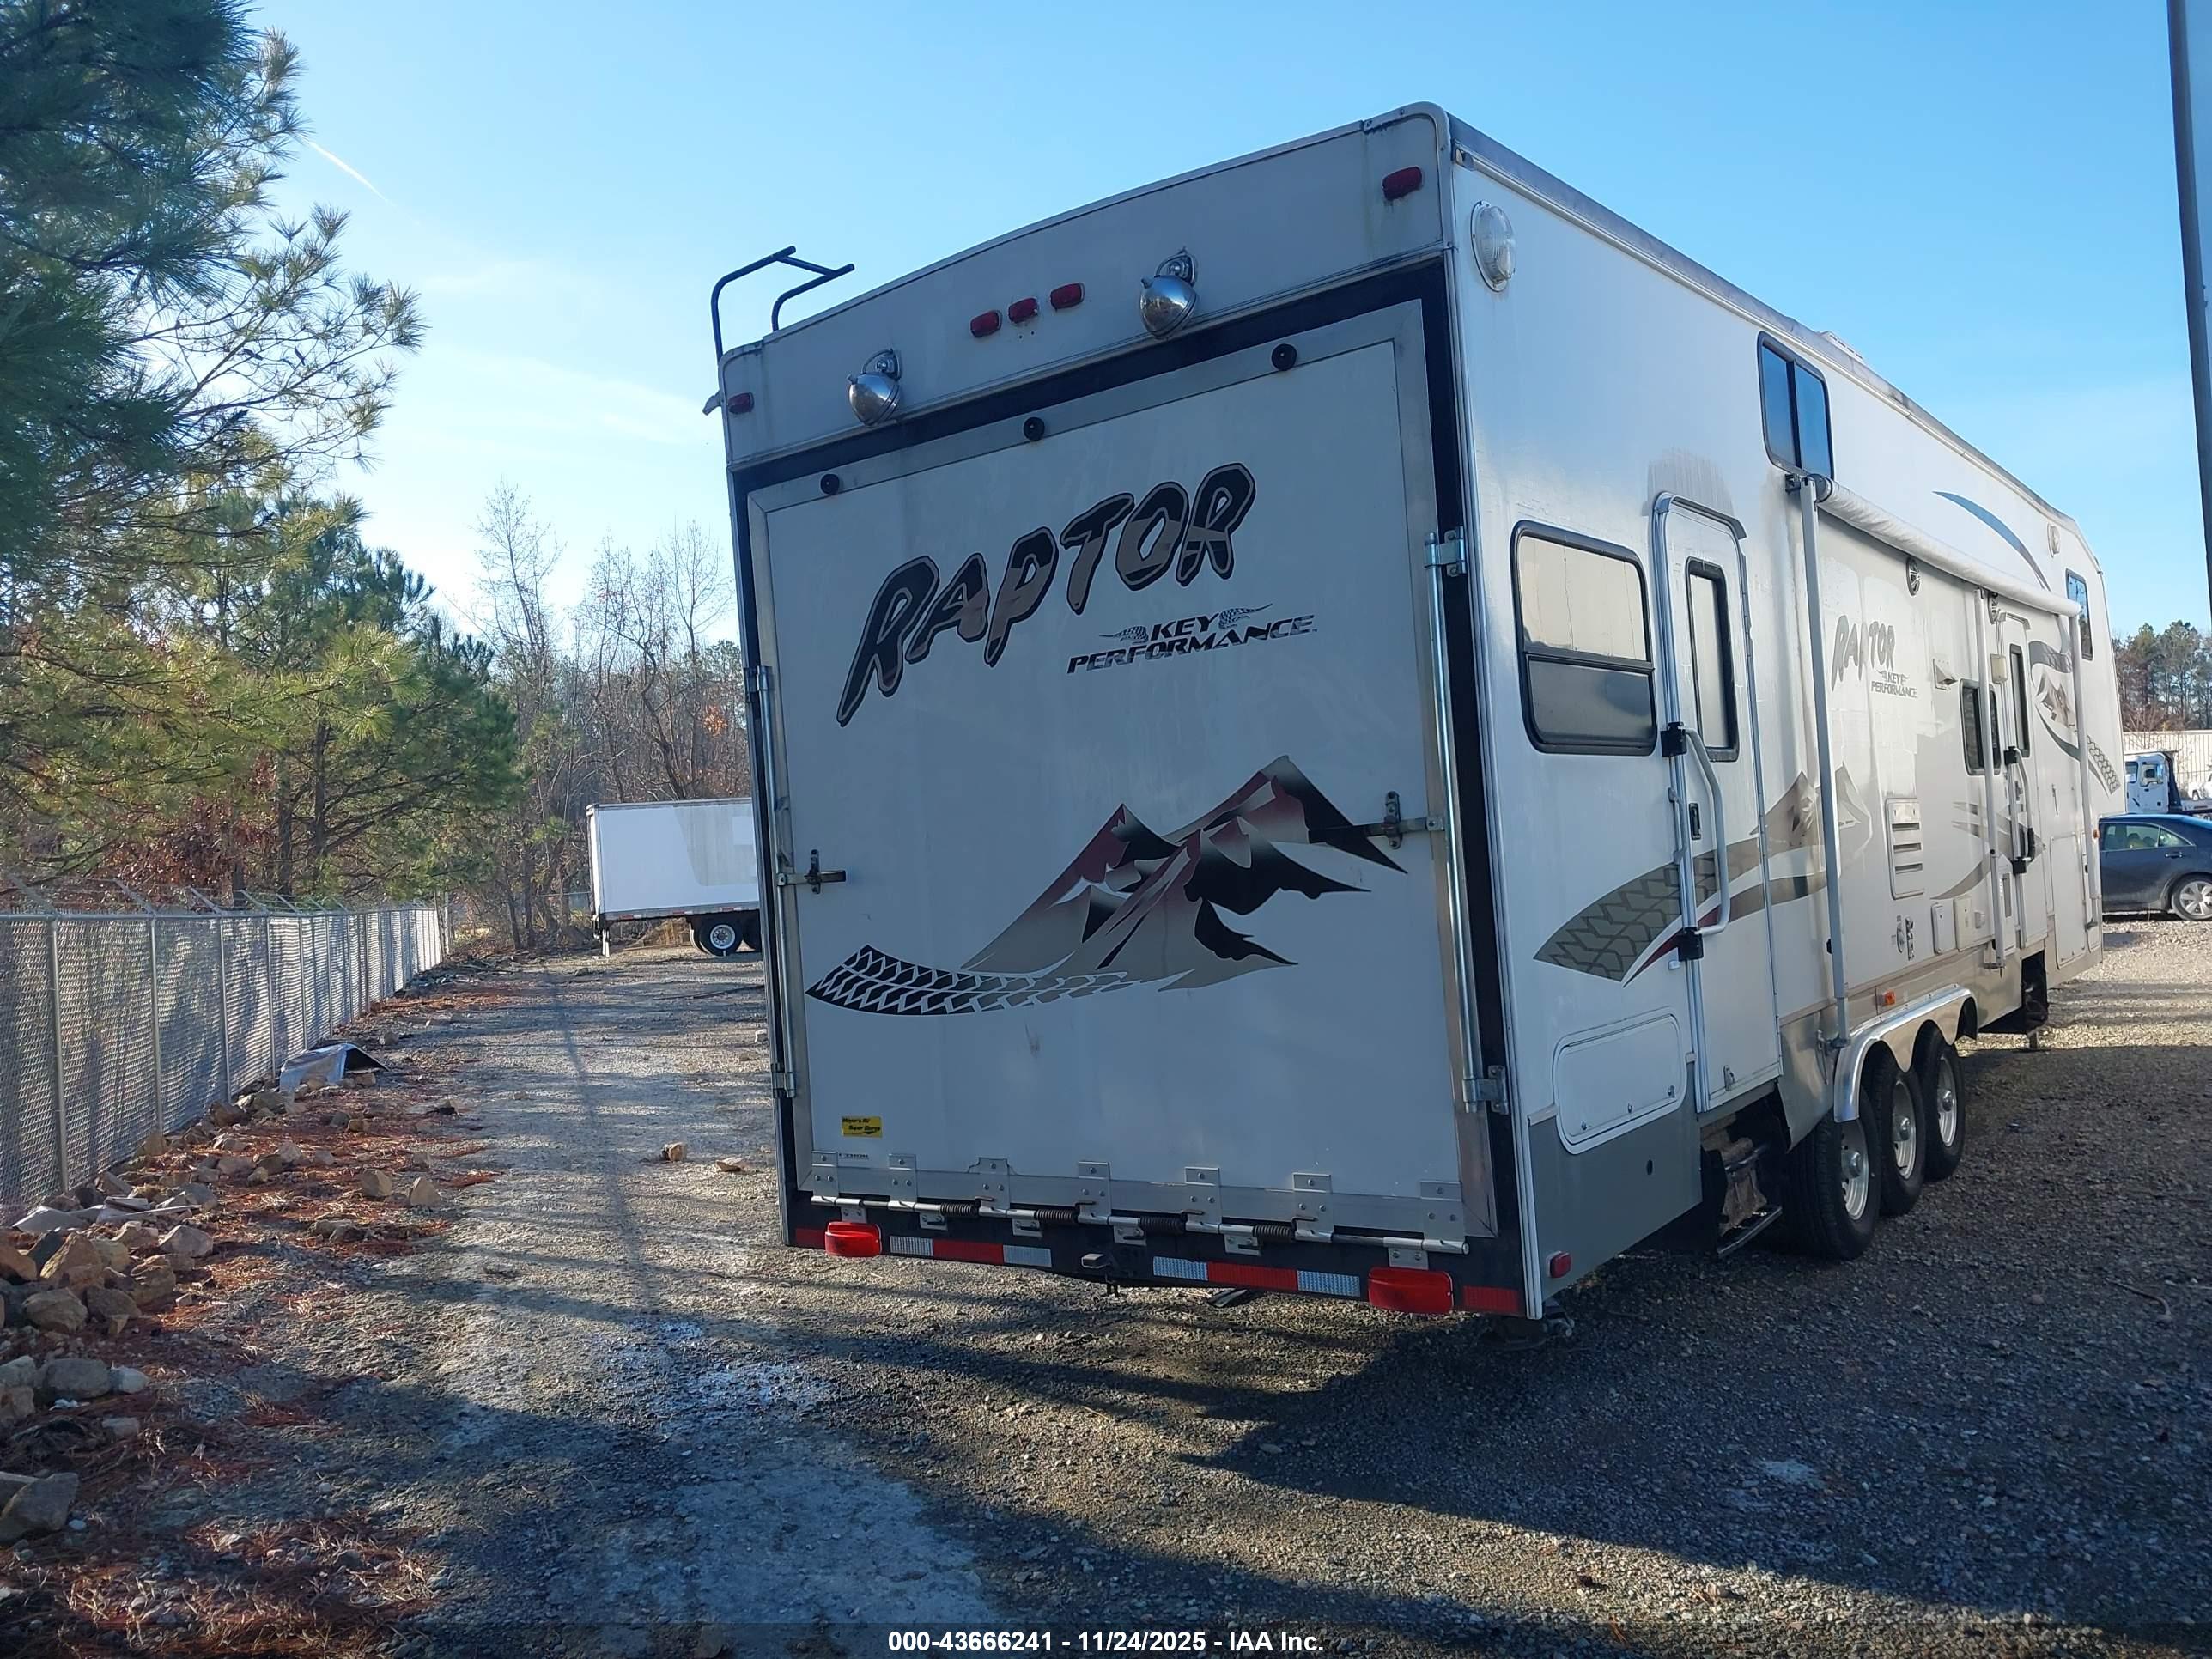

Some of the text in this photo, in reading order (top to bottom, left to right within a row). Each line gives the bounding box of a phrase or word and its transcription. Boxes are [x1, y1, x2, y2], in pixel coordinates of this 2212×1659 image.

[836, 462, 1256, 727] RAPTOR
[1151, 613, 1218, 641] KEY
[1832, 615, 1895, 691] RAPTOR
[1887, 672, 1903, 684] KEY
